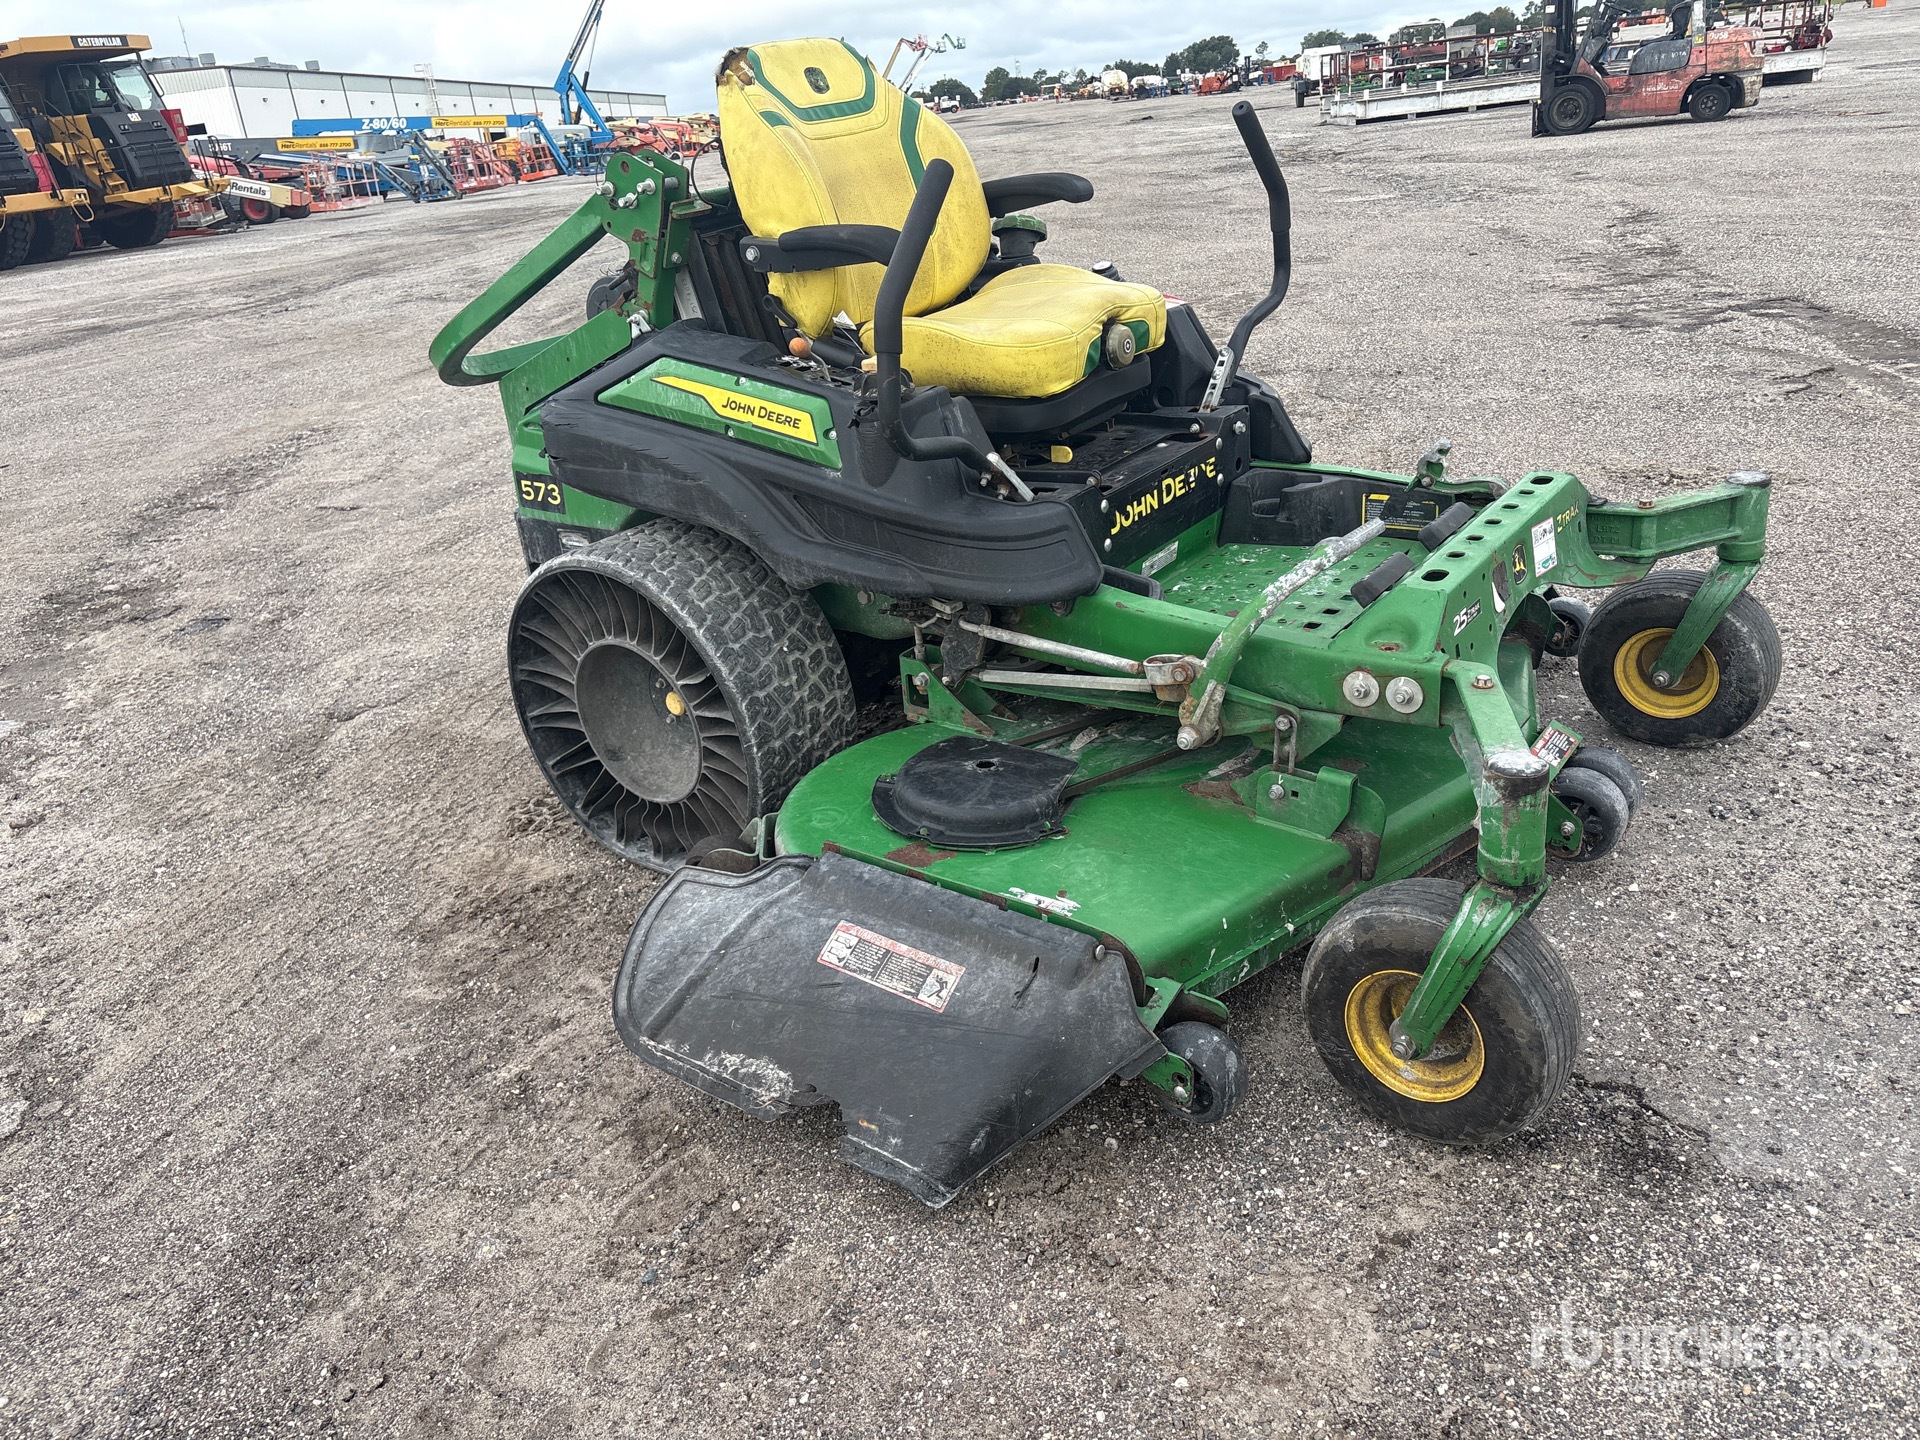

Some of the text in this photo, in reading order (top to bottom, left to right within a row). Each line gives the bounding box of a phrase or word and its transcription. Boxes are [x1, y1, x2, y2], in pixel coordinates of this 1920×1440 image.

[77, 37, 122, 47] CATERPILLAR
[127, 112, 143, 122] CAT
[361, 116, 408, 130] Z-80/60
[231, 181, 267, 196] Rentals
[721, 396, 802, 430] JOHN DEERE
[519, 480, 562, 505] 573
[1110, 489, 1159, 536] JOHN
[1453, 607, 1468, 637] 25
